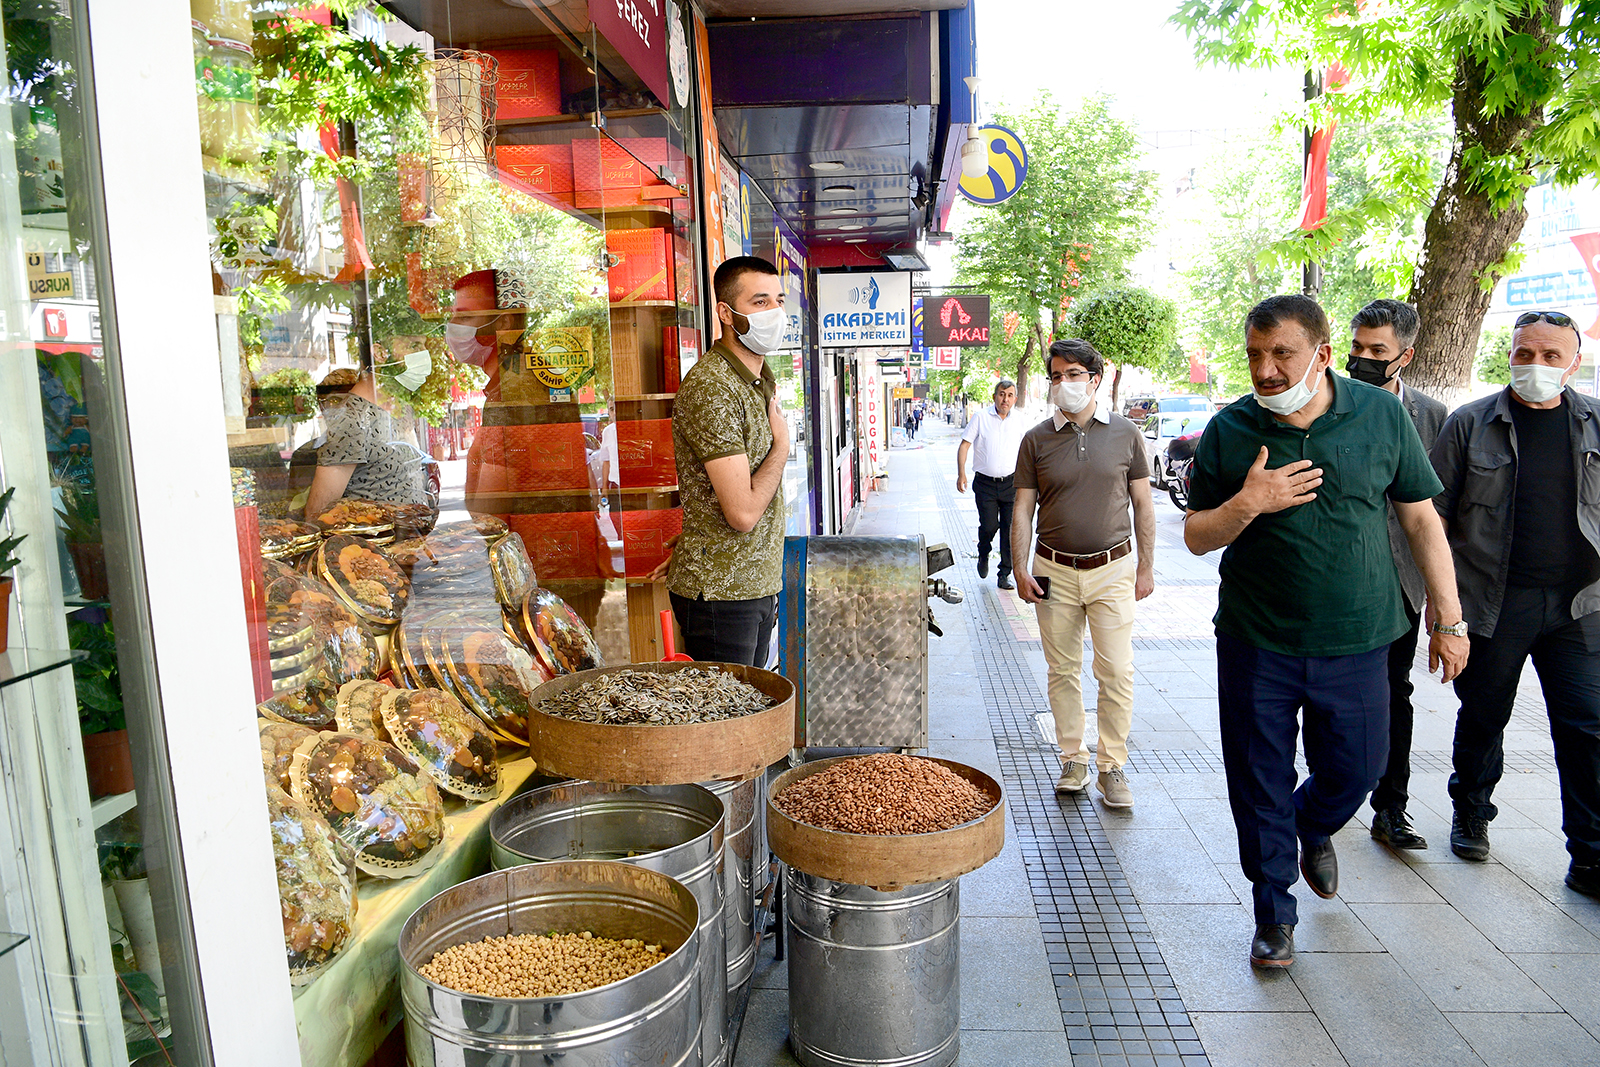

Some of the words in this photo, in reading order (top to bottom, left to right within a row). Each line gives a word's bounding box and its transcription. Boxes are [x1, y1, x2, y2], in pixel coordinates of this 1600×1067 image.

[823, 308, 905, 329] AKADEMİ
[823, 330, 857, 343] İŞİTME
[860, 329, 906, 340] MERKEZİ
[530, 354, 585, 367] ESNAFINA
[538, 370, 563, 386] SAHİP
